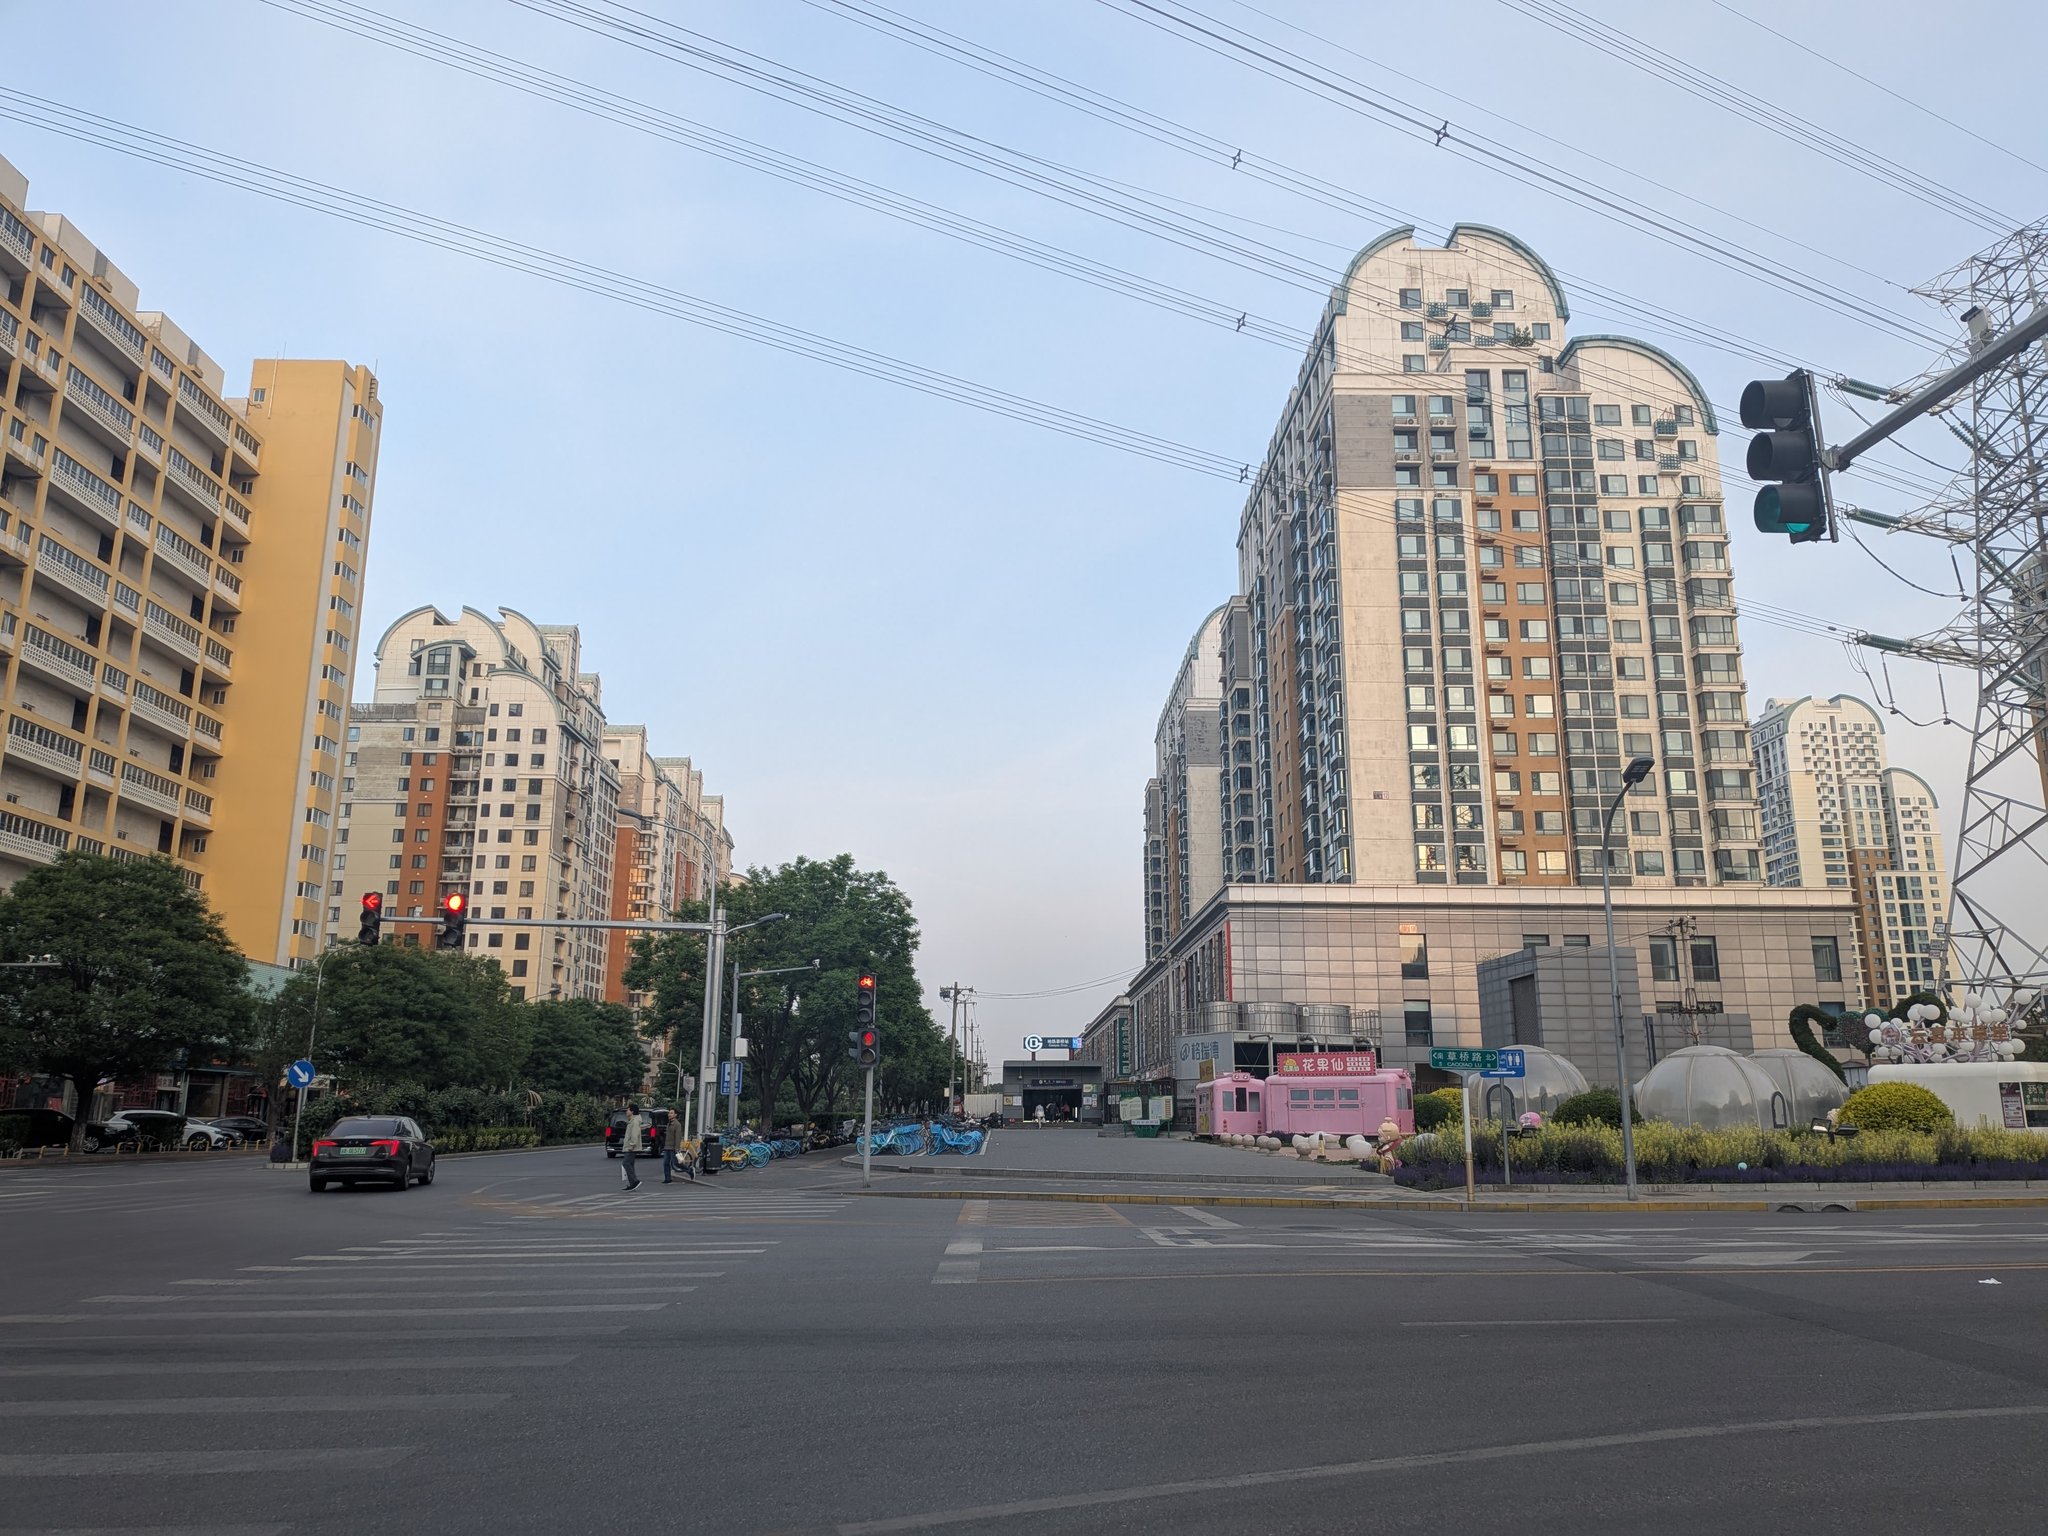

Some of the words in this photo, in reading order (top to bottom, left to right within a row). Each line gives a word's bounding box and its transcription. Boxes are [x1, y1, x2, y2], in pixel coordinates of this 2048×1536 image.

[1446, 1051, 1482, 1062] 草桥路
[1302, 1057, 1344, 1072] 花果仙
